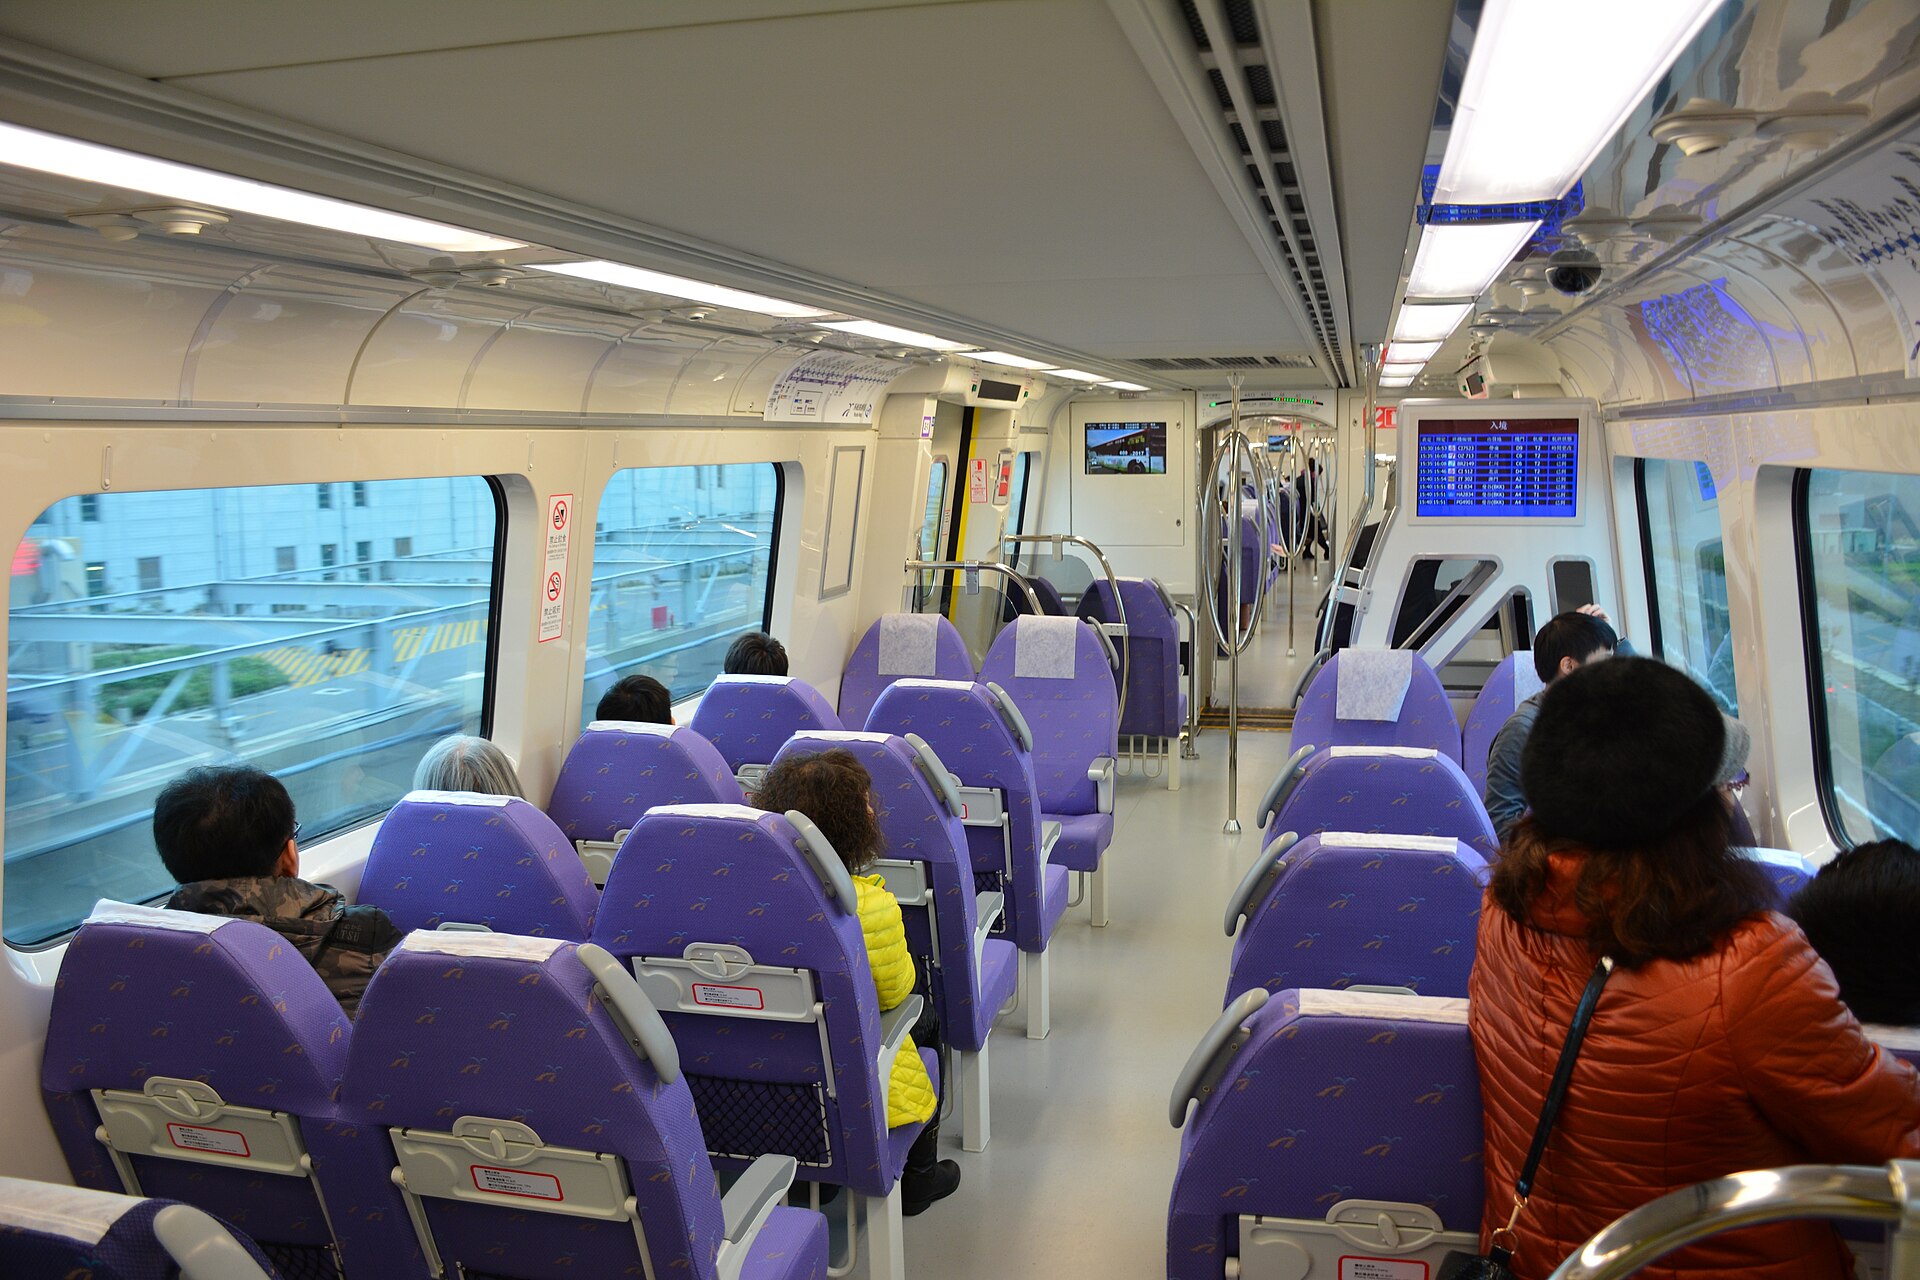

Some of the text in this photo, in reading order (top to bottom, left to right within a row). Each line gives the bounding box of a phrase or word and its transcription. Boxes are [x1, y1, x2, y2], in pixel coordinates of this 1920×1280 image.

[1490, 421, 1507, 430] 入境
[550, 534, 566, 543] 禁止飲食
